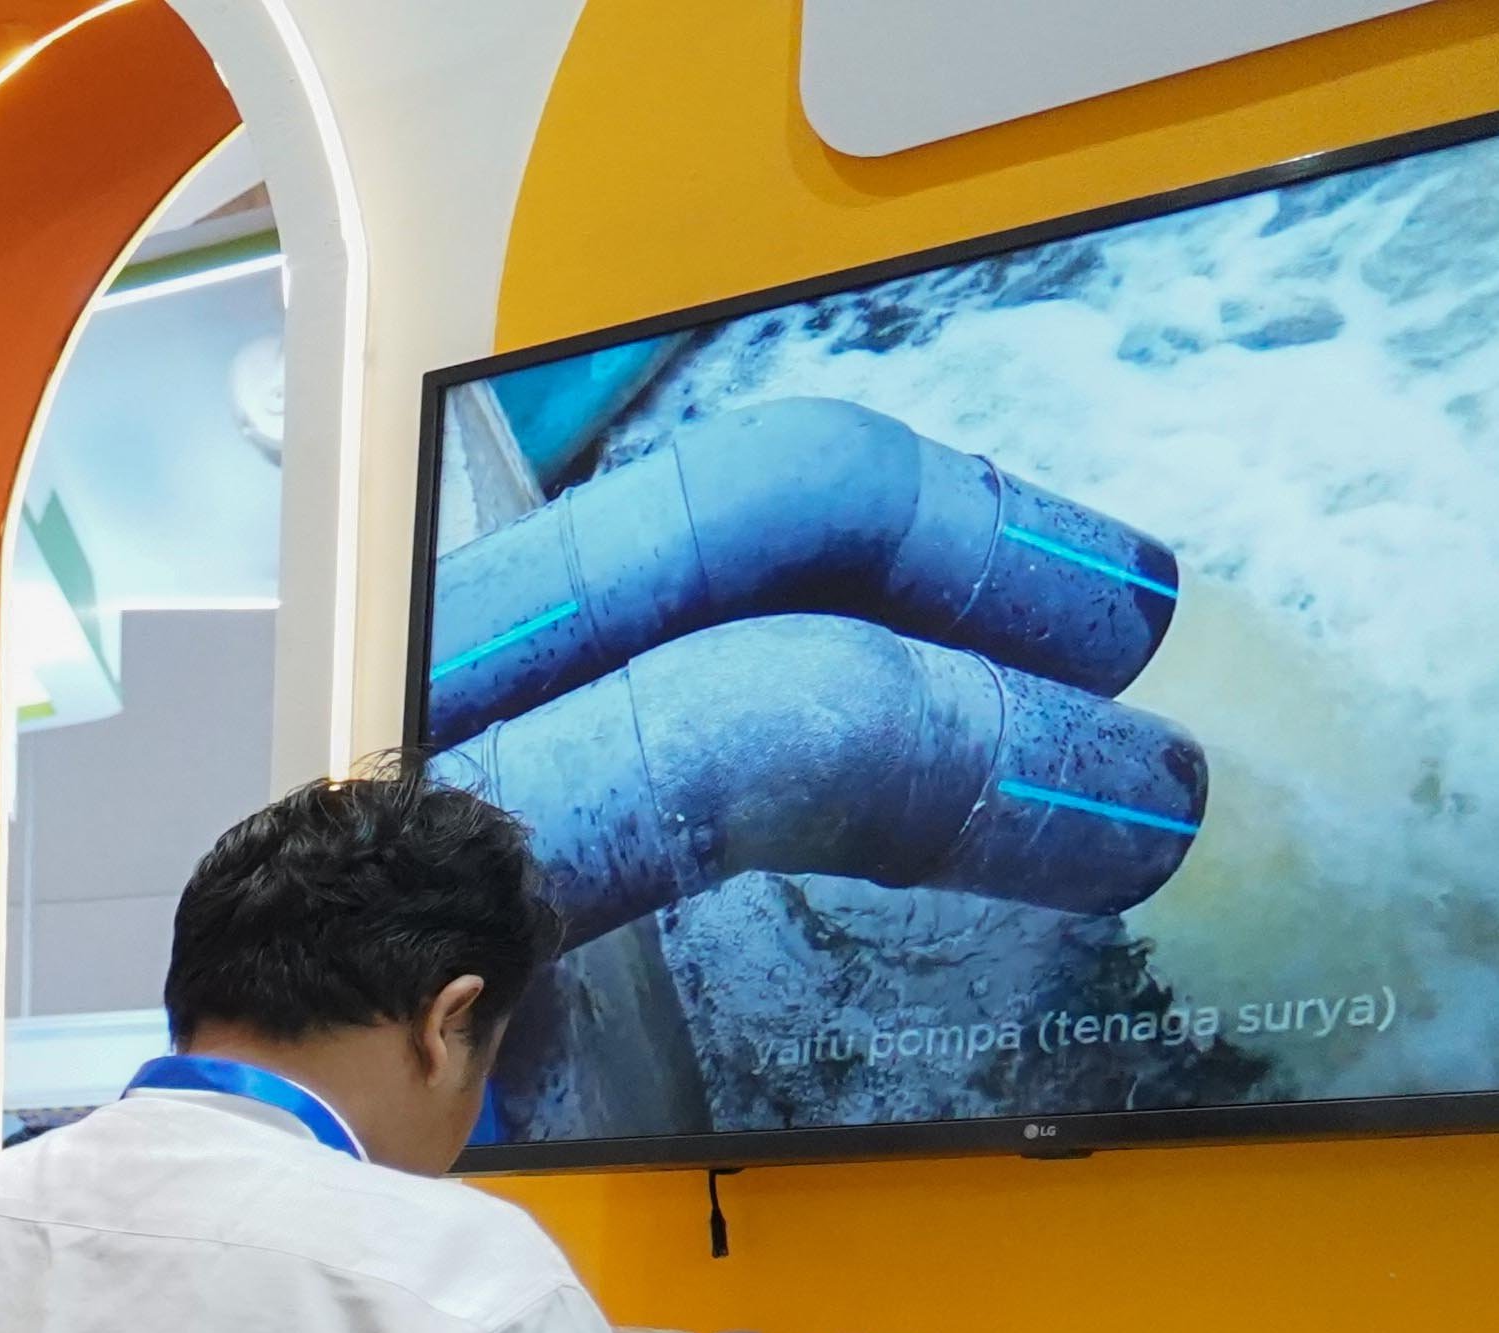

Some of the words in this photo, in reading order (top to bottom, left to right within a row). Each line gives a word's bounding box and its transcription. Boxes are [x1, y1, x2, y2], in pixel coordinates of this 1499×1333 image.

[868, 1020, 1022, 1070] pompa
[1038, 1004, 1218, 1055] (tenaga
[1237, 985, 1397, 1038] surya)
[1040, 1125, 1057, 1137] LG
